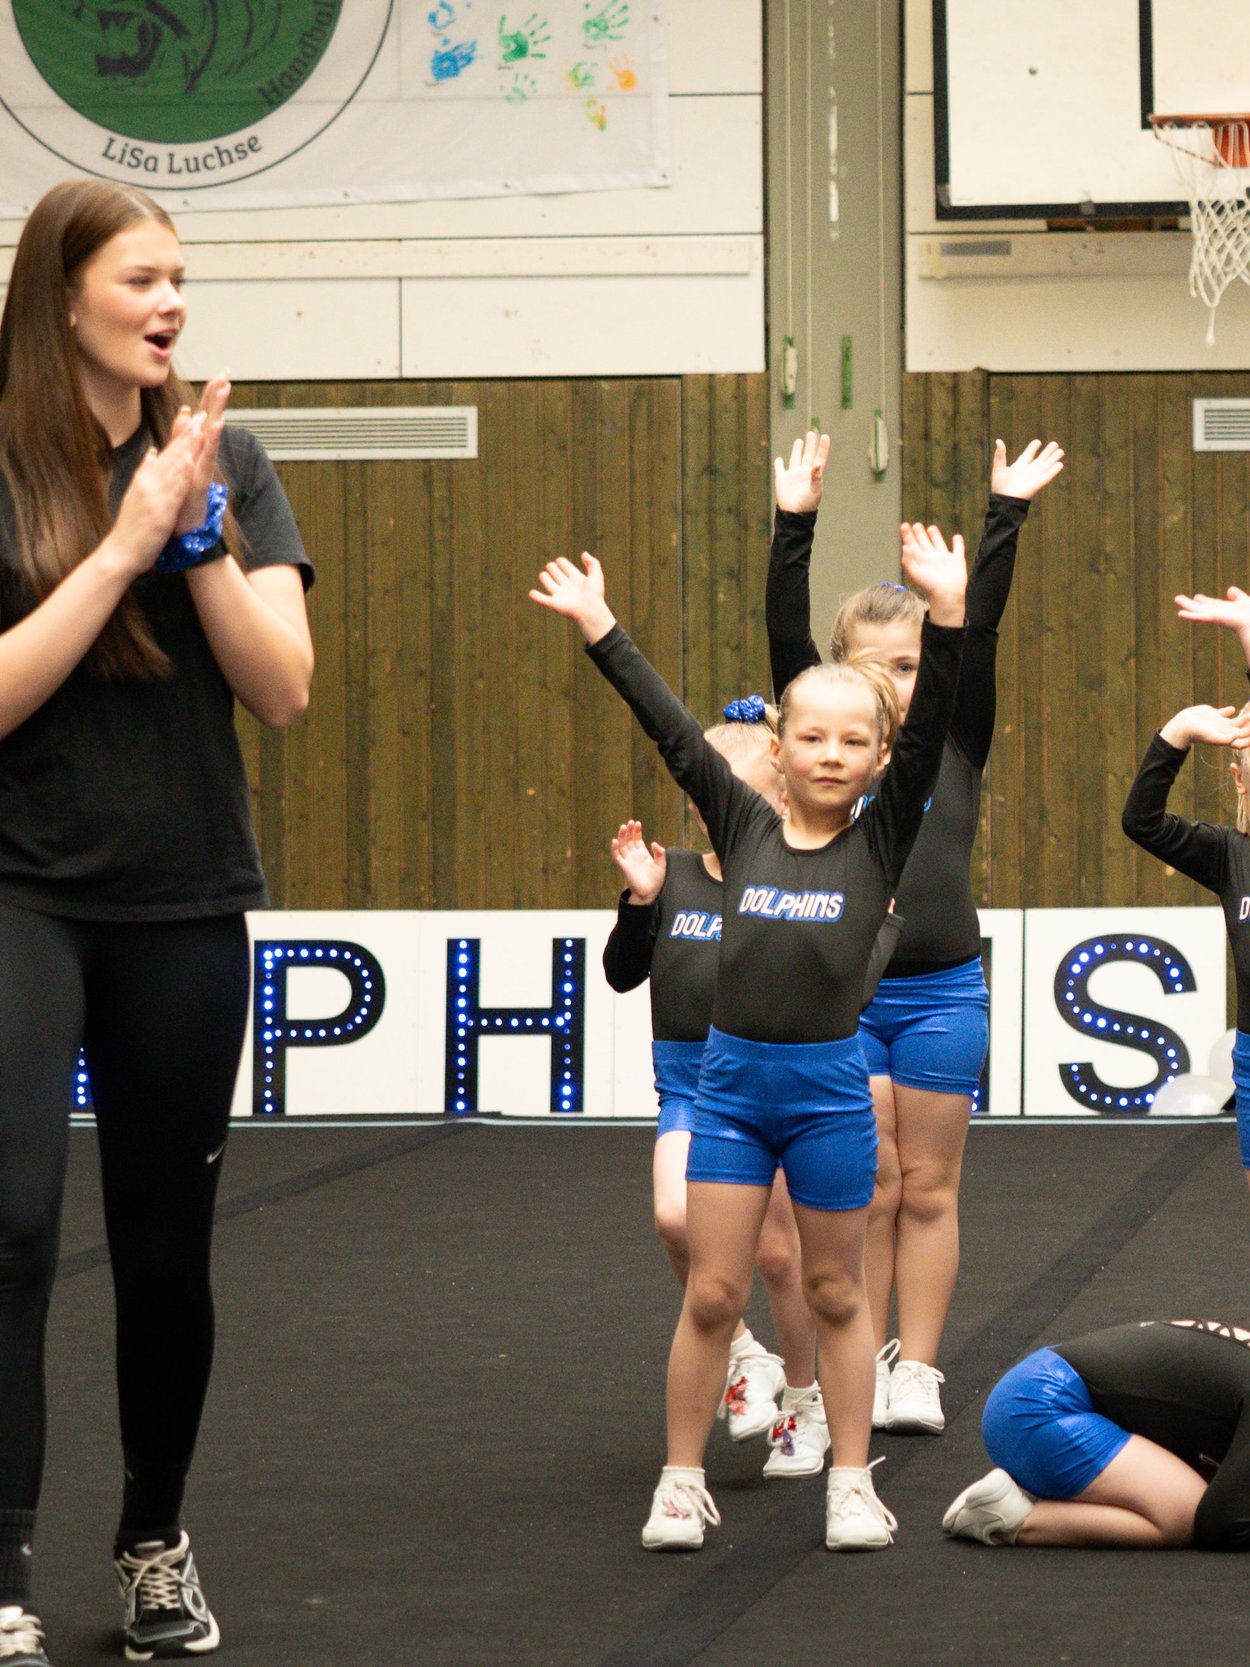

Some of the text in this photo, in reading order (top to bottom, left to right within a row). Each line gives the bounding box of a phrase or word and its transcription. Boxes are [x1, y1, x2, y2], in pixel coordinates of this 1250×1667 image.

[101, 135, 263, 174] LiSa Luchse
[738, 887, 844, 919] DOLPHINS
[671, 913, 723, 938] DOLP
